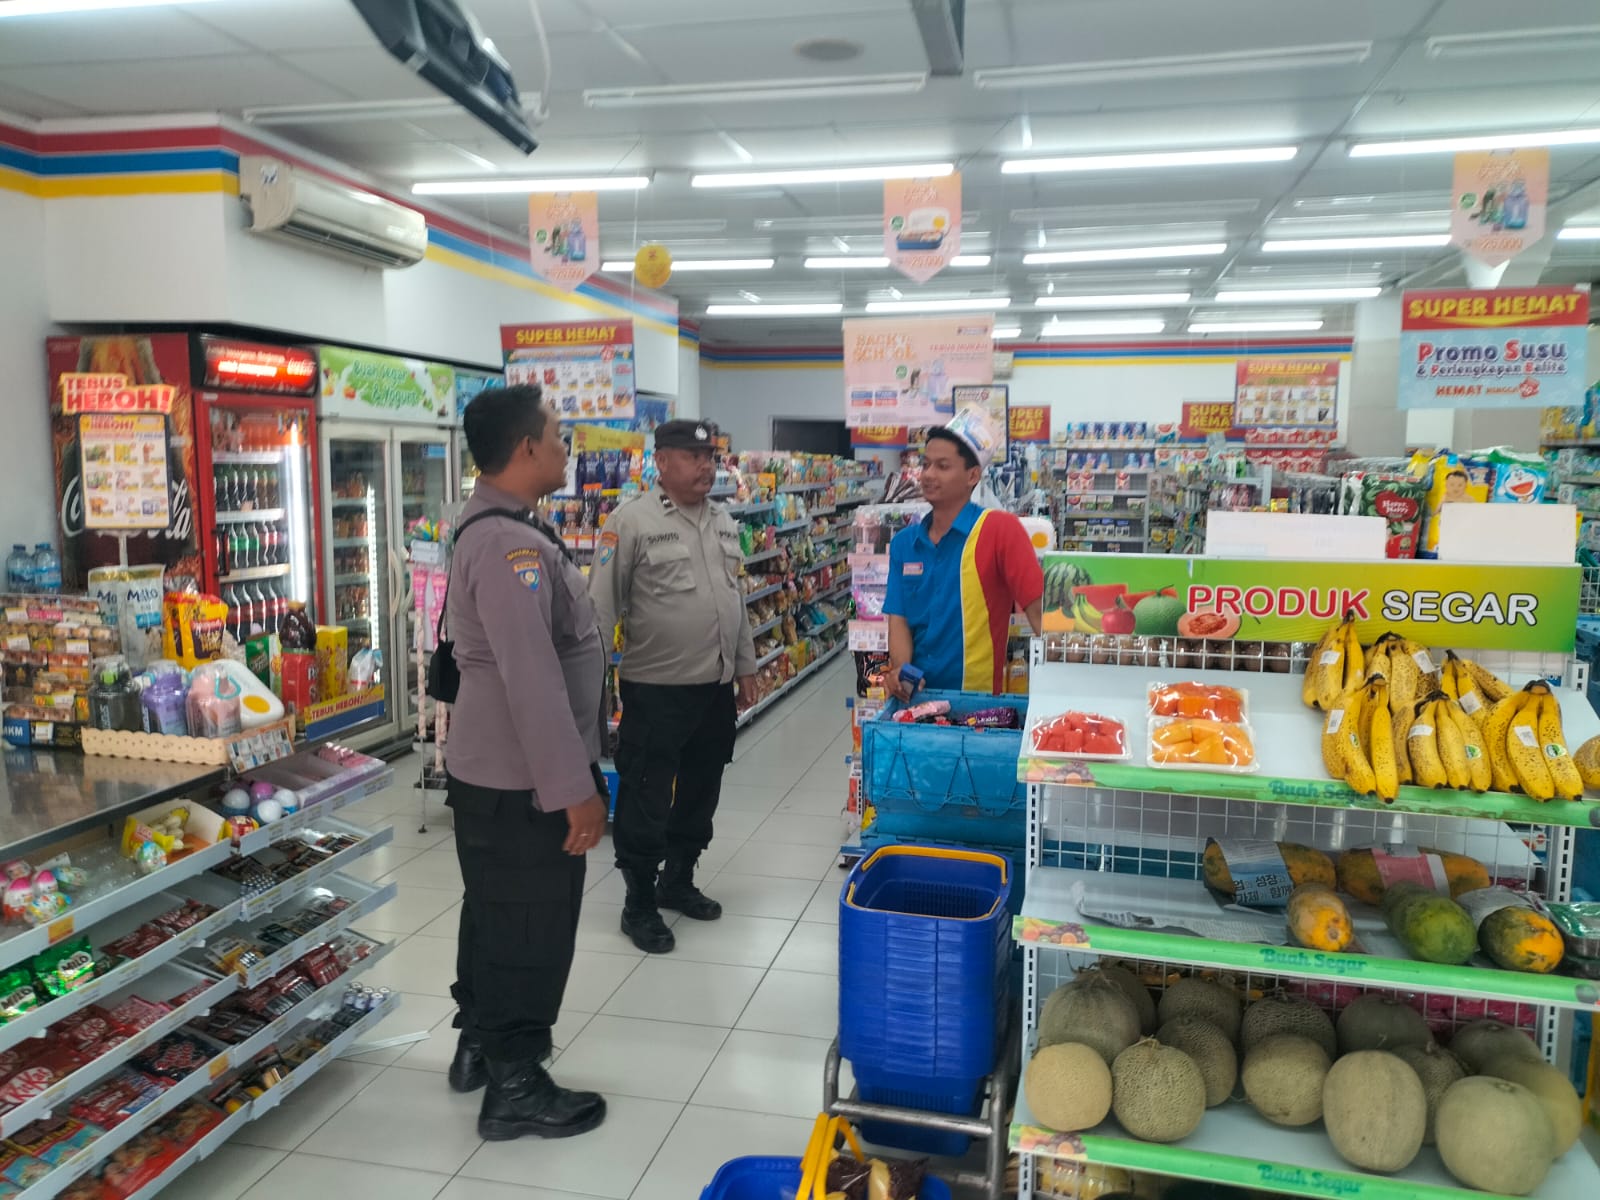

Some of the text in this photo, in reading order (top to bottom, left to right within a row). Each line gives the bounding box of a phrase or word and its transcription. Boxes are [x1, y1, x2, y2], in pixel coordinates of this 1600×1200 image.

[1408, 294, 1580, 319] SUPER HEMAT
[516, 326, 616, 344] SUPER HEMAT
[1418, 340, 1567, 362] Promo Susu
[1248, 361, 1327, 374] SUPER HEMAT
[1417, 365, 1425, 376] &
[66, 376, 123, 390] TEBUS
[1436, 385, 1483, 397] HEMAT
[66, 387, 172, 412] HEBOH!
[1009, 408, 1044, 419] UPER
[1188, 416, 1232, 428] HEMA
[1009, 419, 1043, 430] EMAT
[1187, 585, 1538, 626] PRODUK SEGAR
[1268, 780, 1374, 804] Buah Sega
[61, 955, 89, 971] MILO
[1260, 948, 1367, 973] Buah Segar
[8, 1068, 50, 1103] KitKat
[1257, 1164, 1363, 1194] Buah Segar
